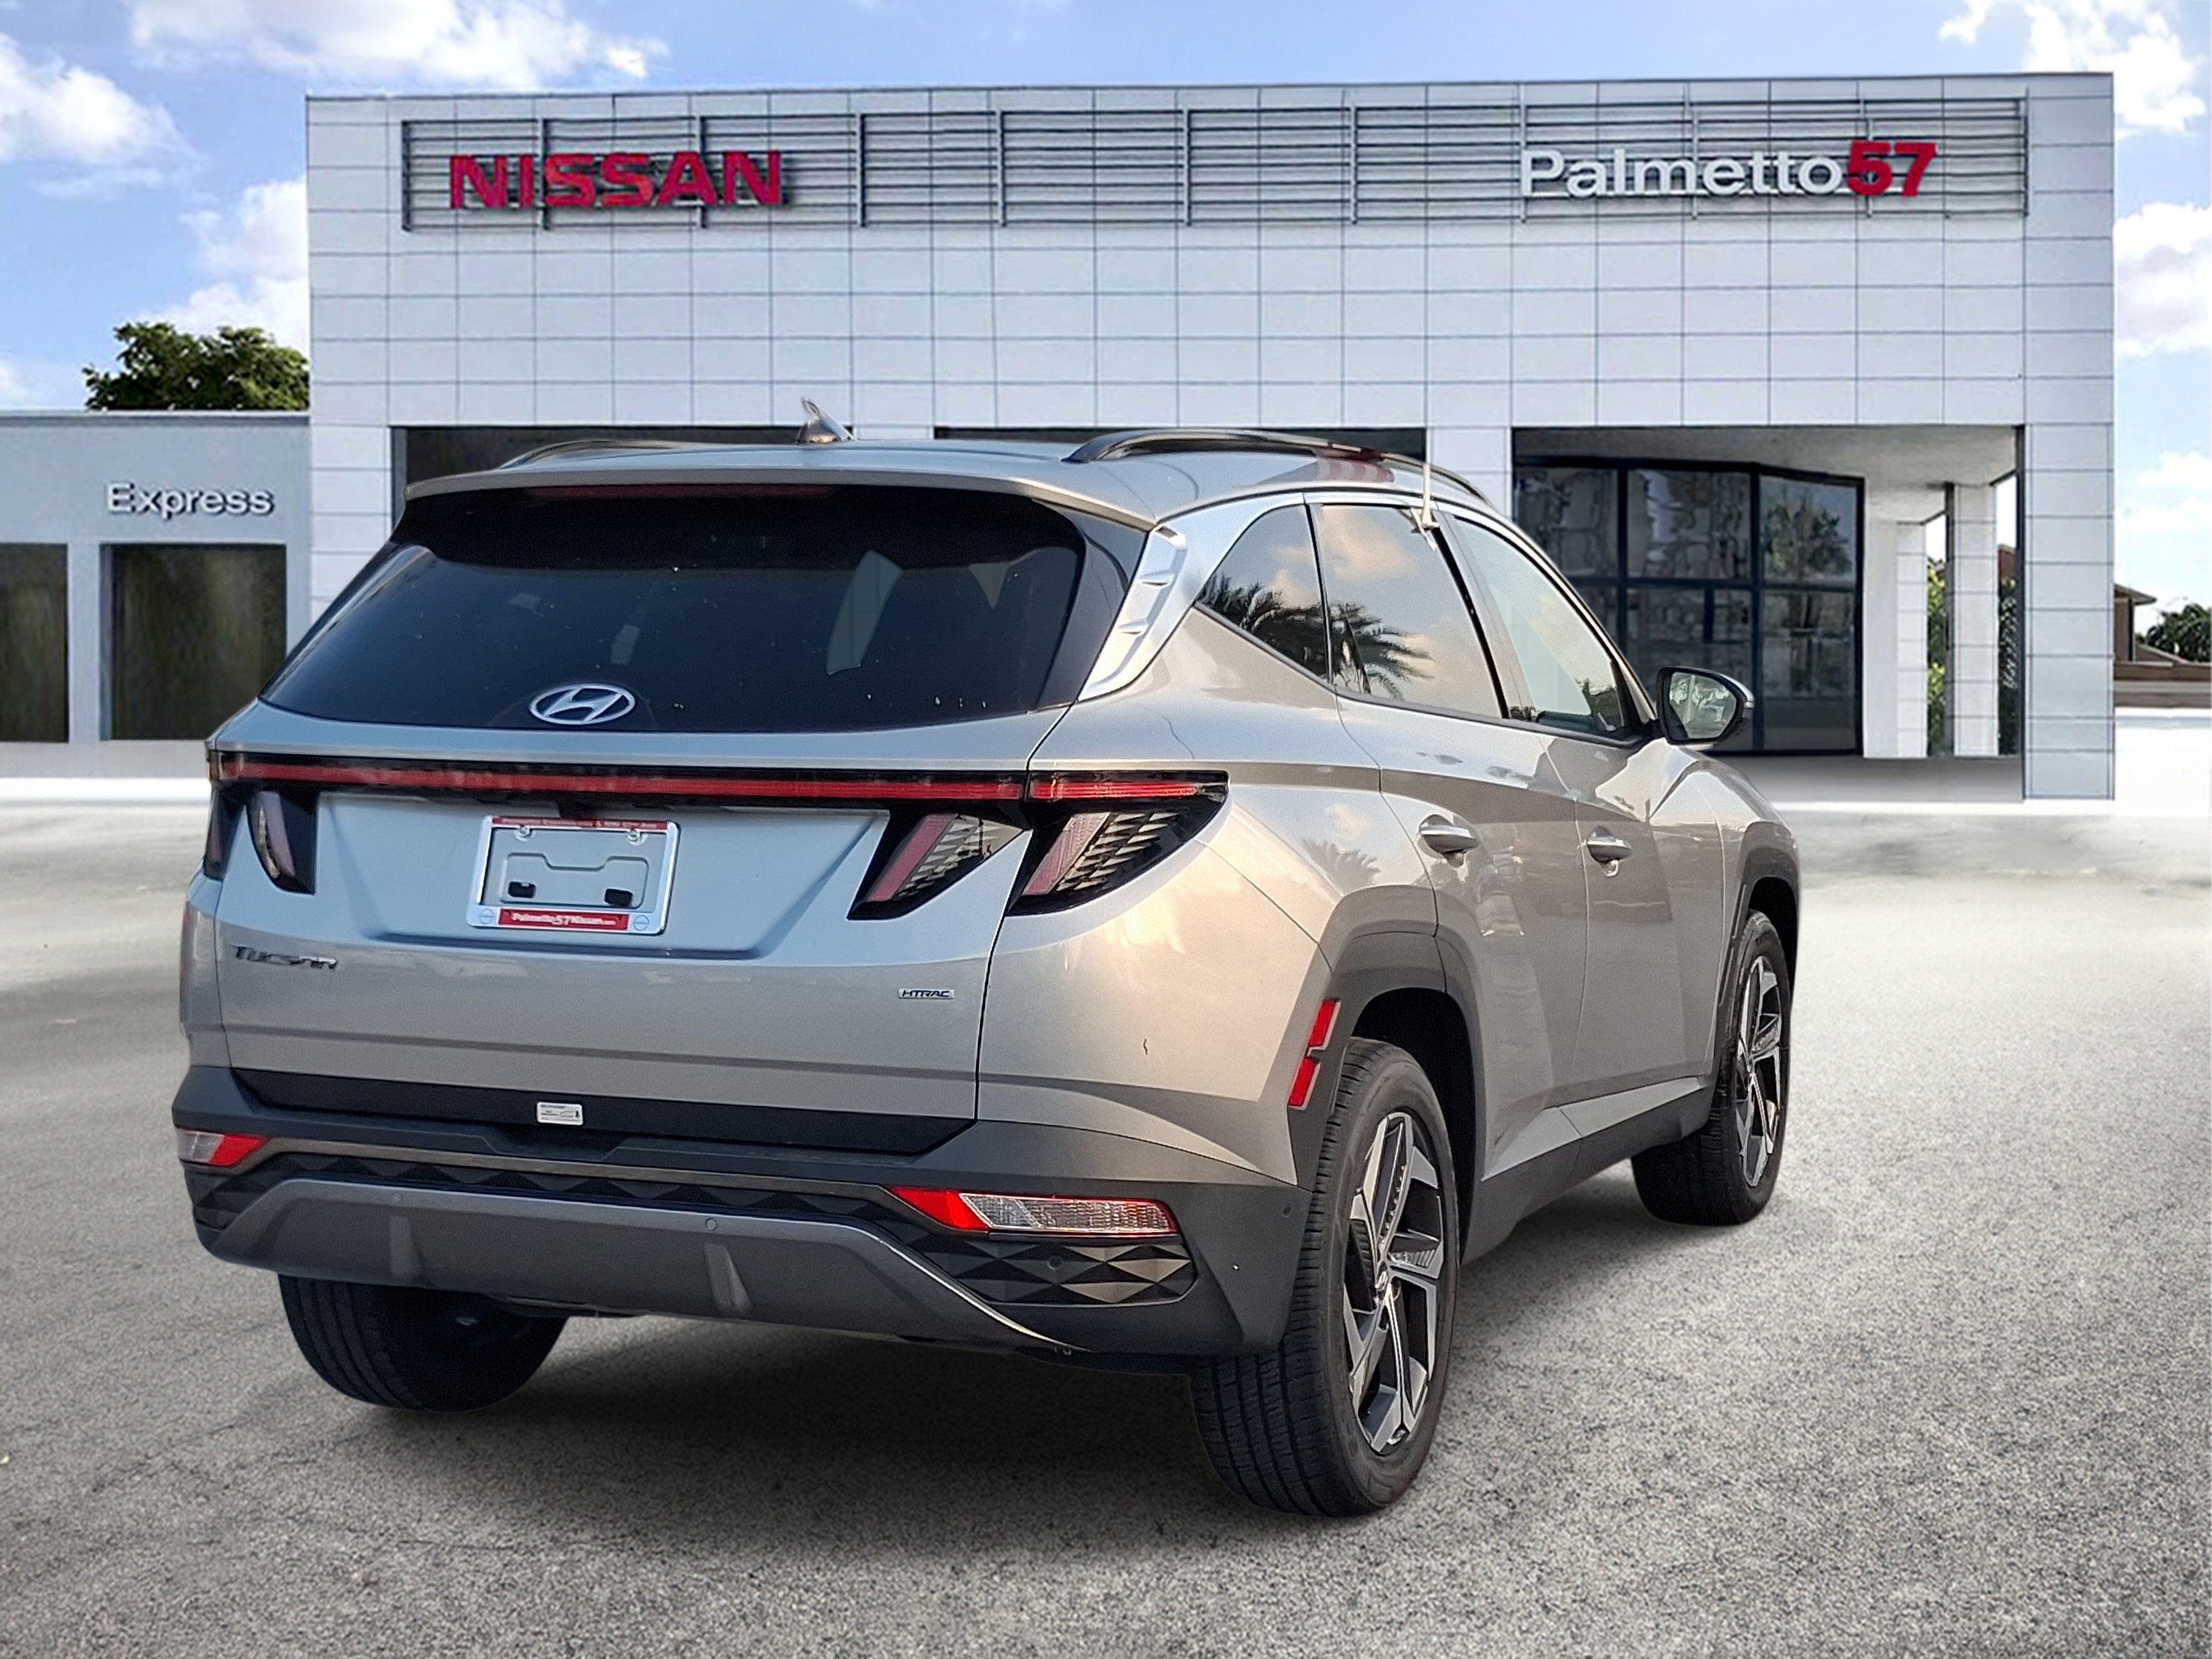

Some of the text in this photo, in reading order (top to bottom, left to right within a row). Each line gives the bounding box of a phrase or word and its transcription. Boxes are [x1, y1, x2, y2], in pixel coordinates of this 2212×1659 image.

[450, 150, 781, 209] NISSAN
[1520, 139, 1936, 198] Palmetto57
[107, 481, 275, 520] Express
[901, 989, 950, 998] HTRAC
